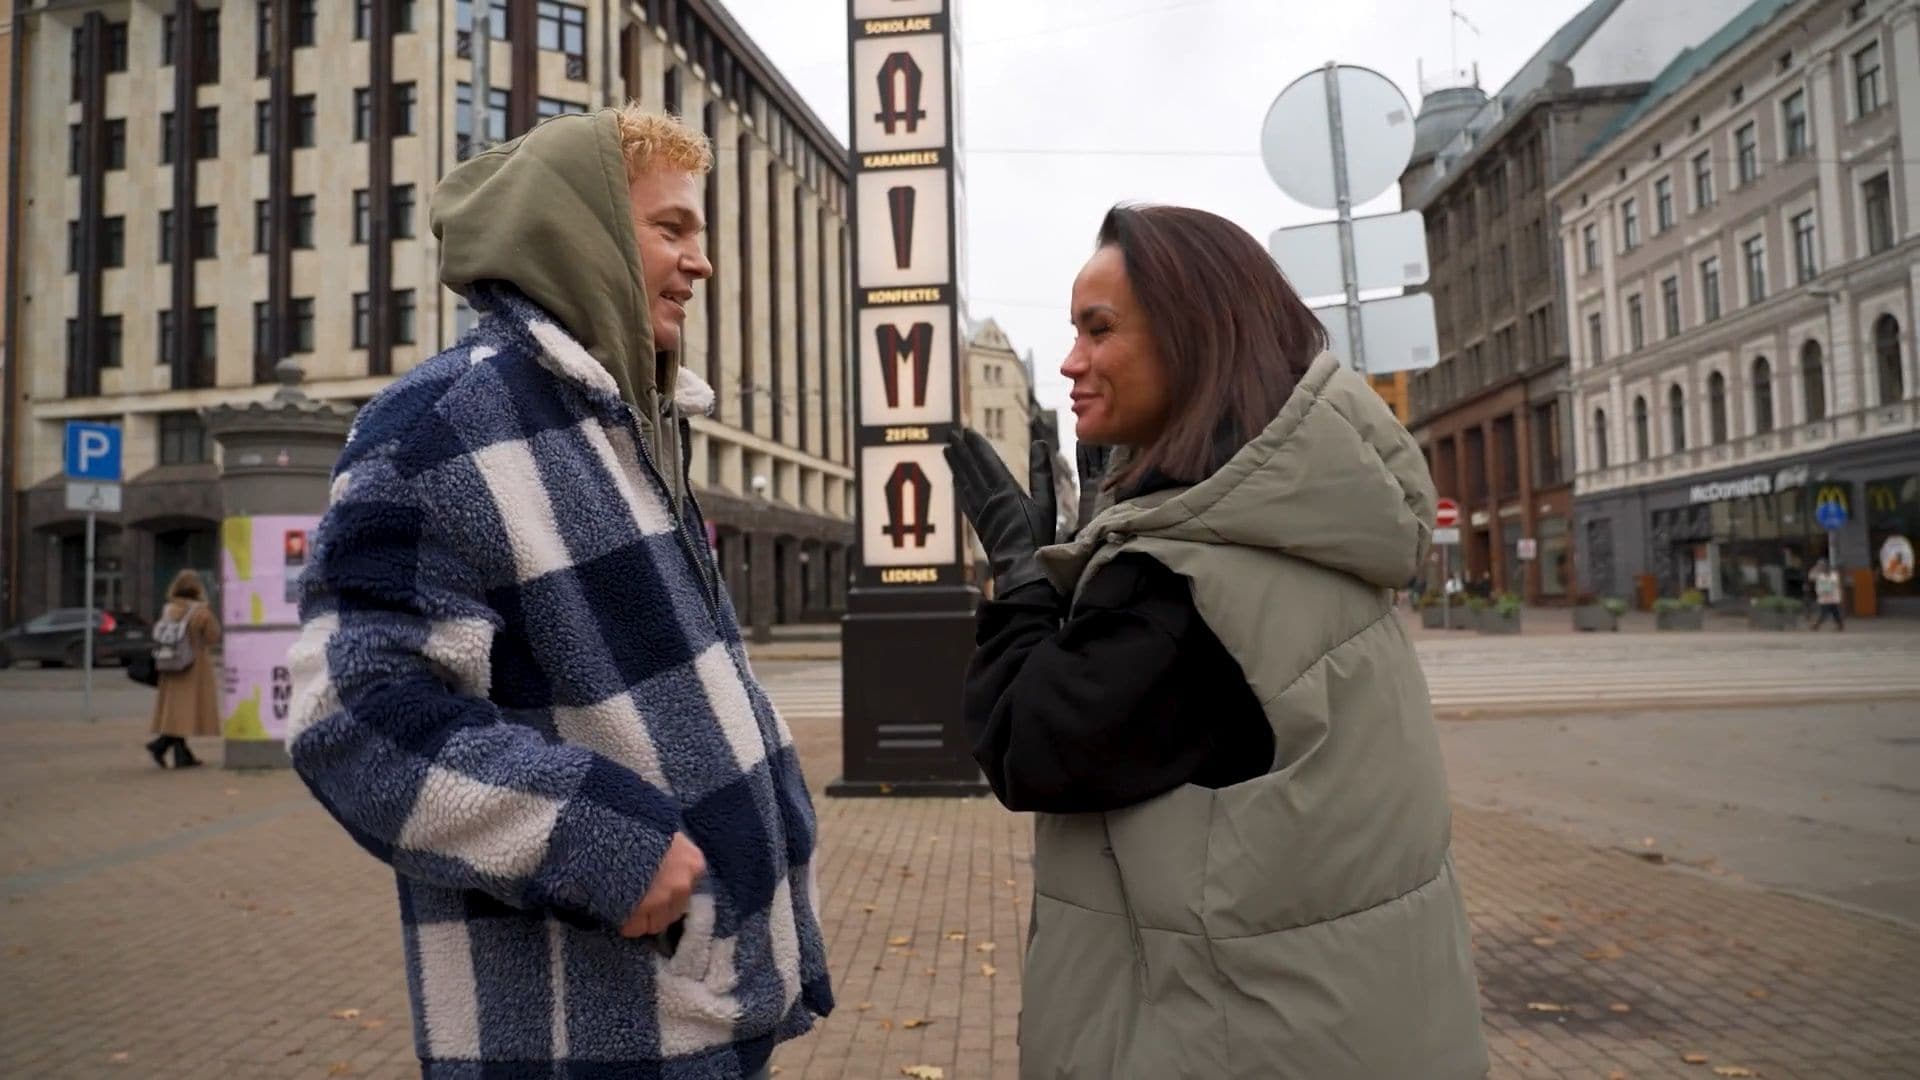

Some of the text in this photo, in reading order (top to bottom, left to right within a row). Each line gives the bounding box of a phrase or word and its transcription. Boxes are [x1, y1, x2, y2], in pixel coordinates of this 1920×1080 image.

[863, 151, 939, 168] KARAMELES
[867, 287, 940, 305] KONFEKTES
[80, 430, 110, 473] P
